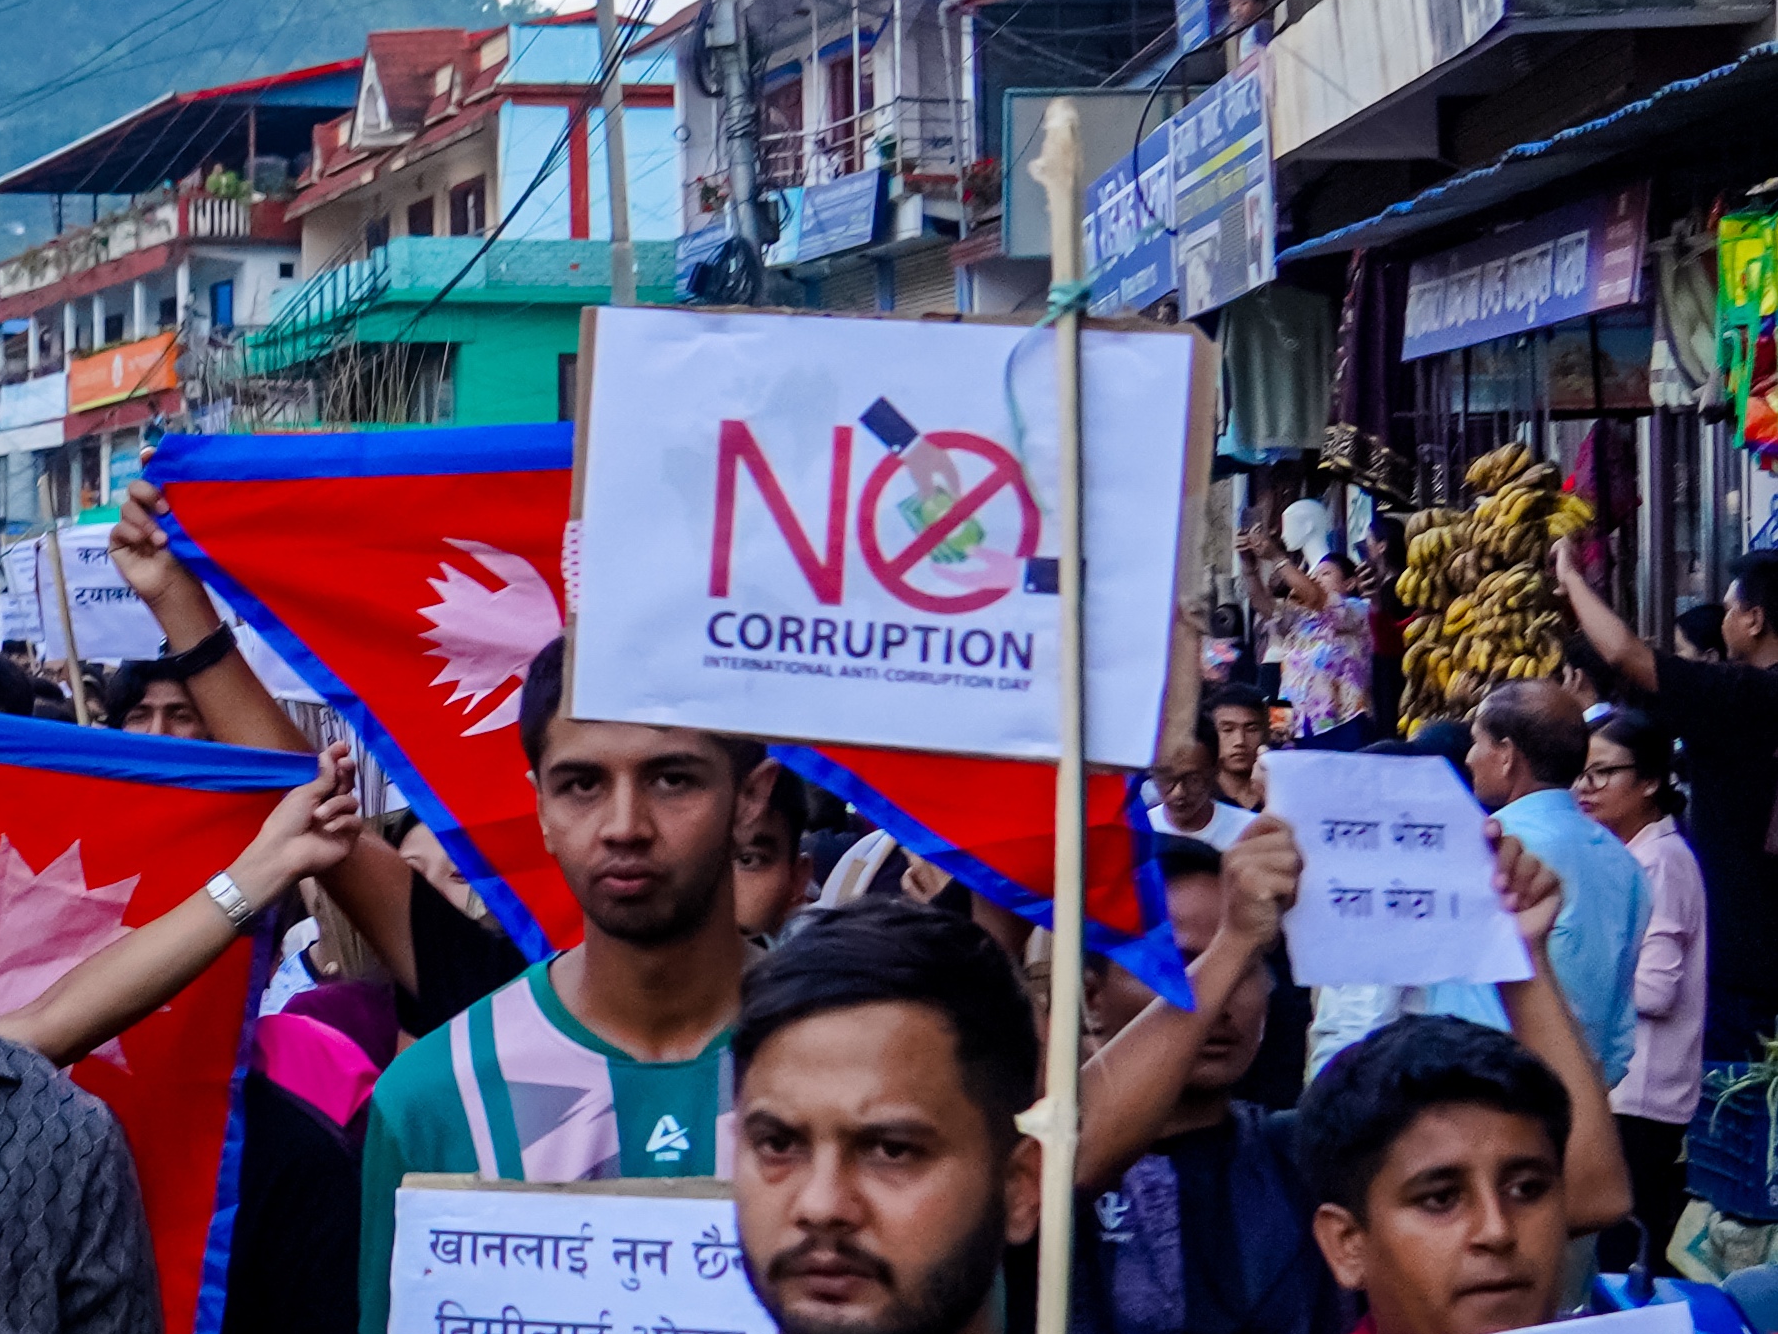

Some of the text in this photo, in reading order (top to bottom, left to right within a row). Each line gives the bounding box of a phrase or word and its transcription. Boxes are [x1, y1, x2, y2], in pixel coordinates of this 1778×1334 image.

[706, 610, 1034, 670] CORRUPTION
[703, 654, 834, 678] INTERNATIONAL
[997, 674, 1032, 692] DAY
[428, 1222, 593, 1278] खानलाई
[612, 1236, 673, 1292] नुन
